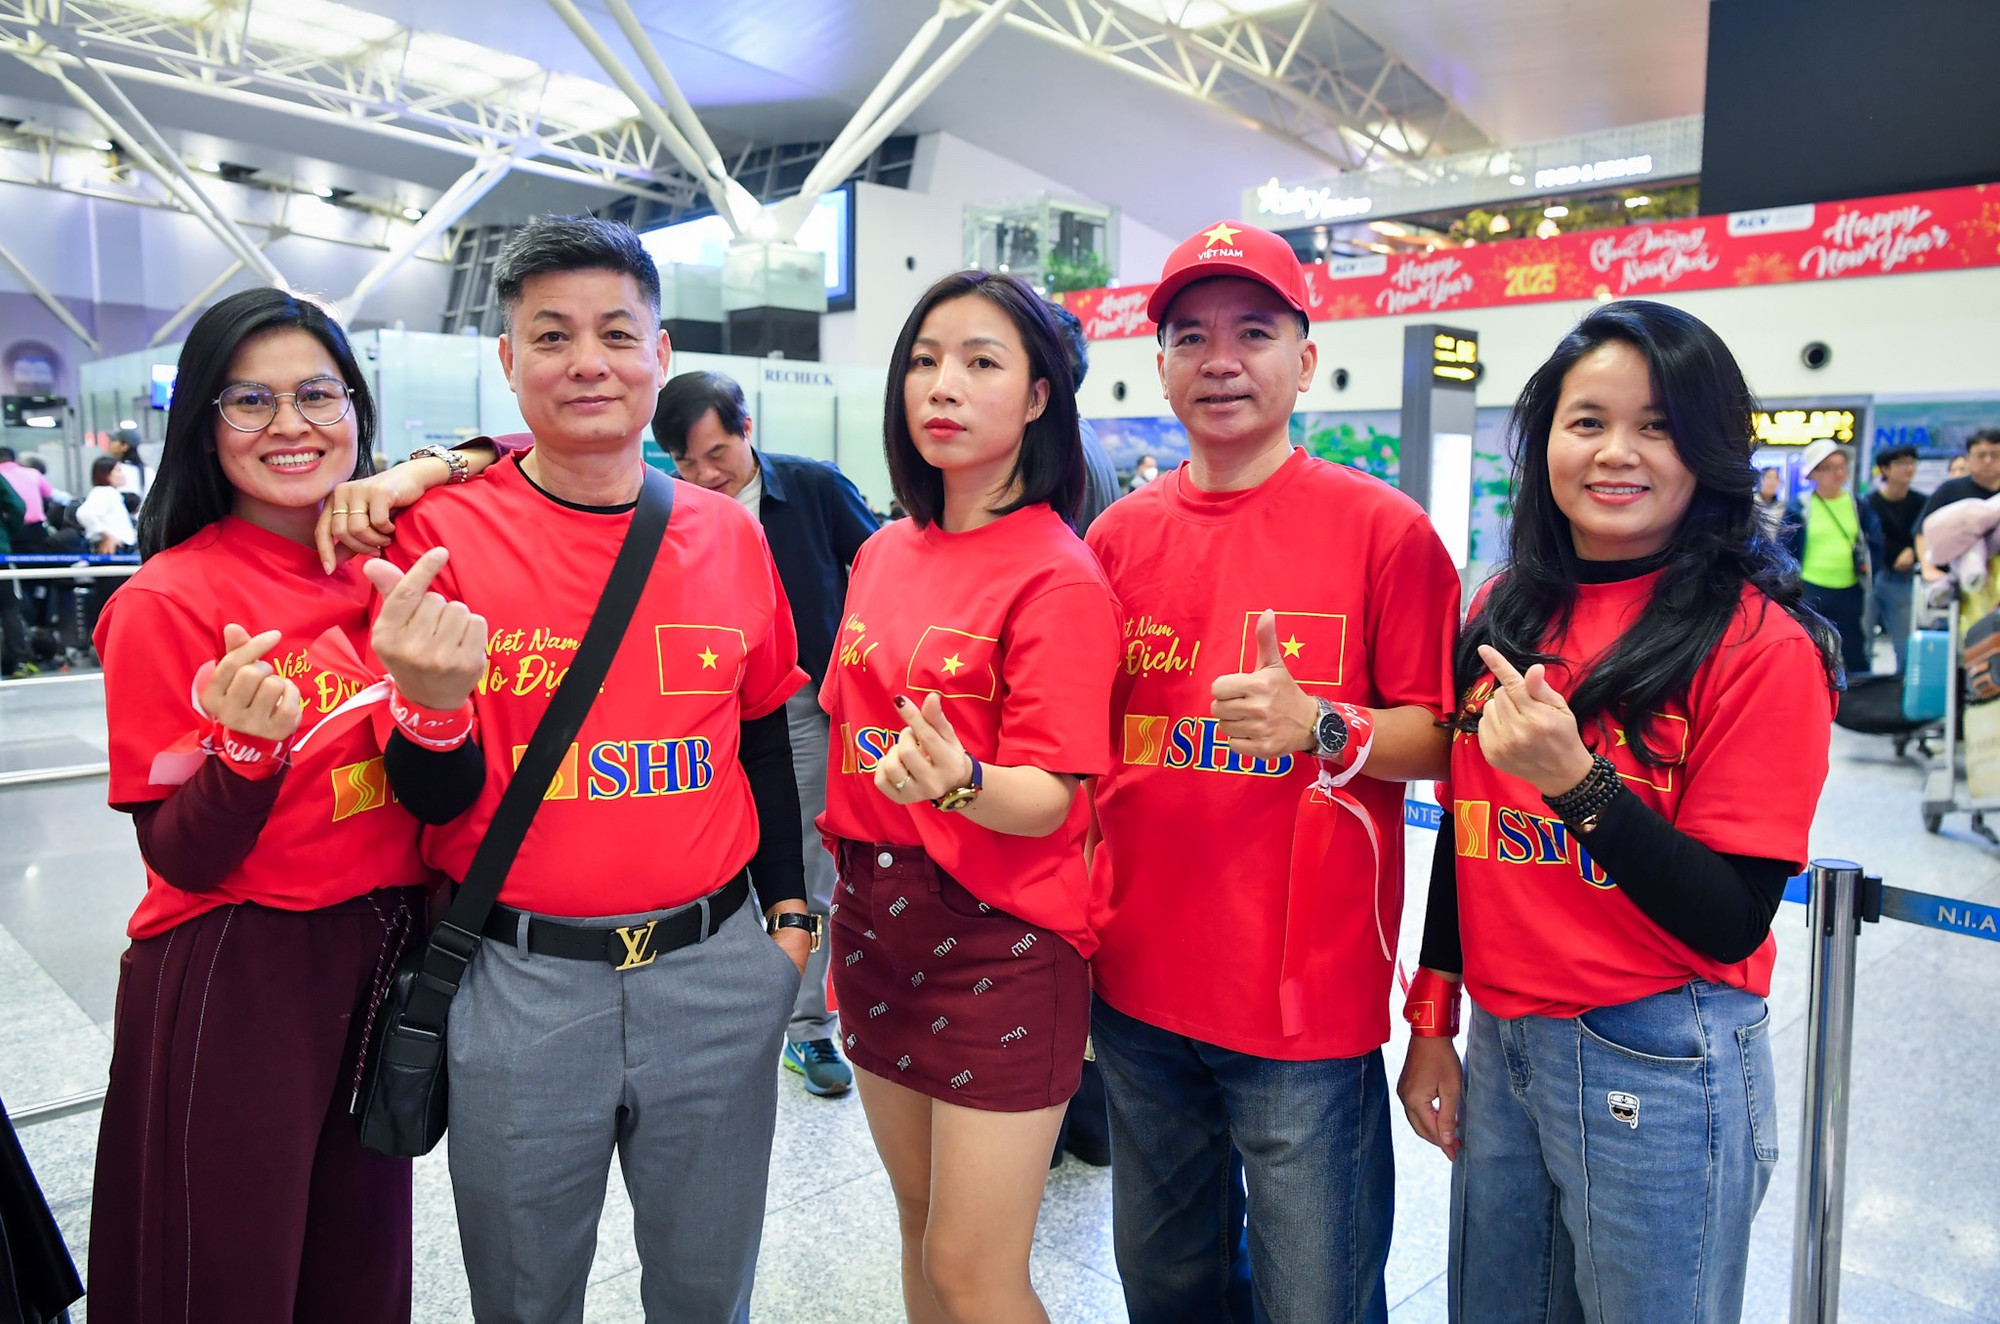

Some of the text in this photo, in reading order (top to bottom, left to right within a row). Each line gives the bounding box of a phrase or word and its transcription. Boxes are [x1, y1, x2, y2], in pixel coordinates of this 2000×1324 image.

[1823, 205, 1932, 248] Happy
[1219, 249, 1243, 258] NAM
[1390, 256, 1462, 290] Happy
[1504, 263, 1557, 297] 2025
[765, 369, 832, 386] RECHECK
[1875, 426, 1931, 446] NIA
[528, 627, 581, 652] Nam
[1134, 616, 1175, 637] Nam
[1125, 637, 1200, 678] Địch!
[588, 736, 715, 800] SHB
[1937, 905, 1997, 933] N.I.A
